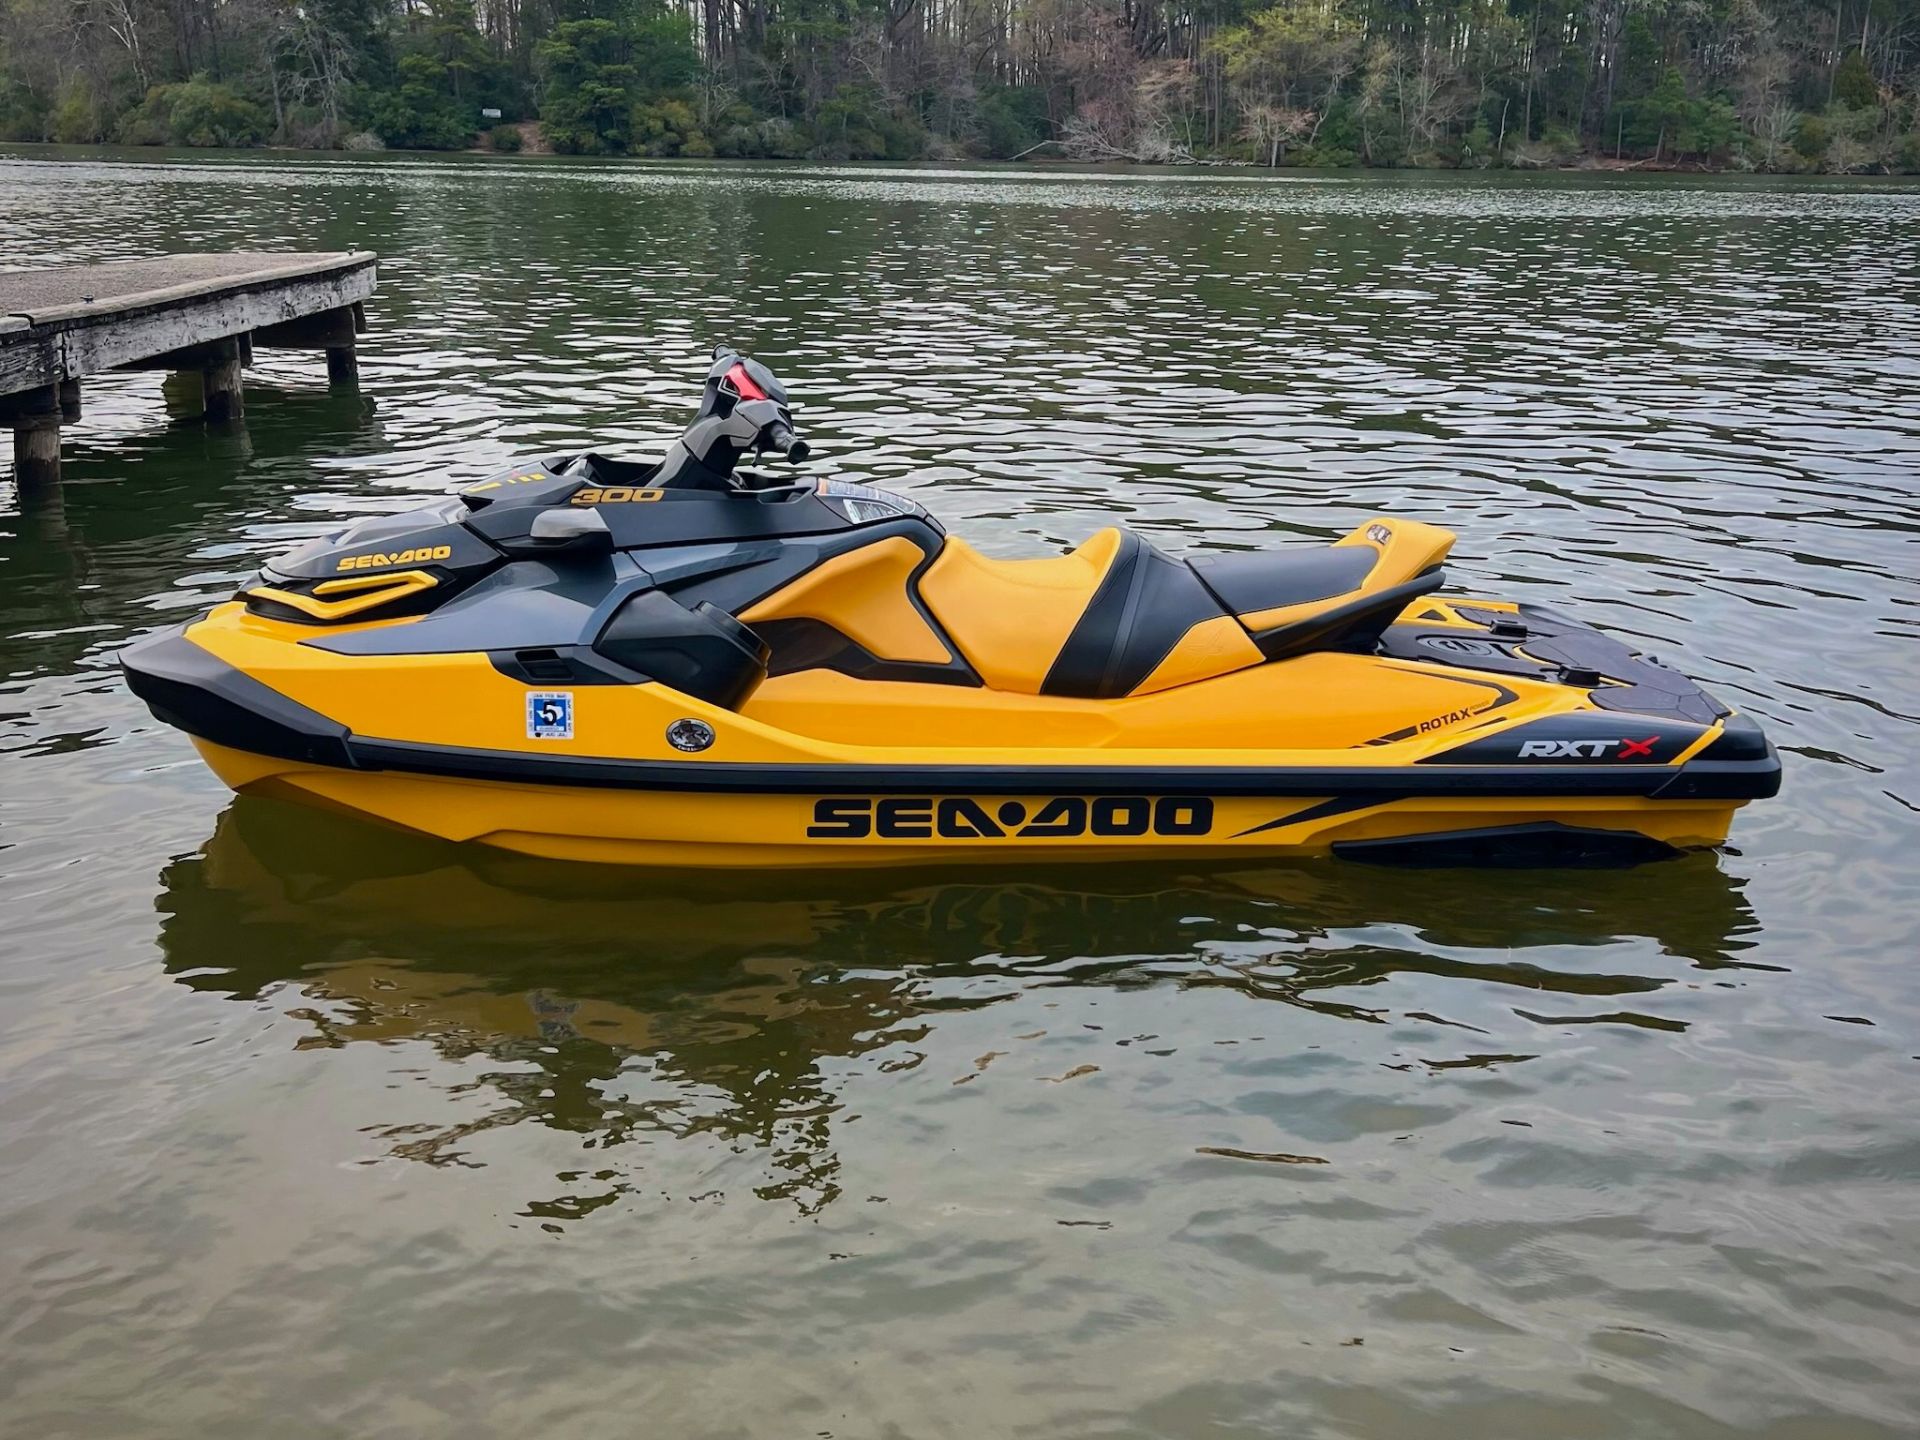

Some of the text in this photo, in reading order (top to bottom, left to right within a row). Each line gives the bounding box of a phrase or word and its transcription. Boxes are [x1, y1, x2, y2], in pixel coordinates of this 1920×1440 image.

[571, 488, 665, 504] 300
[543, 701, 557, 726] 5
[1420, 708, 1471, 732] ROTAX
[1517, 735, 1661, 759] RXT X
